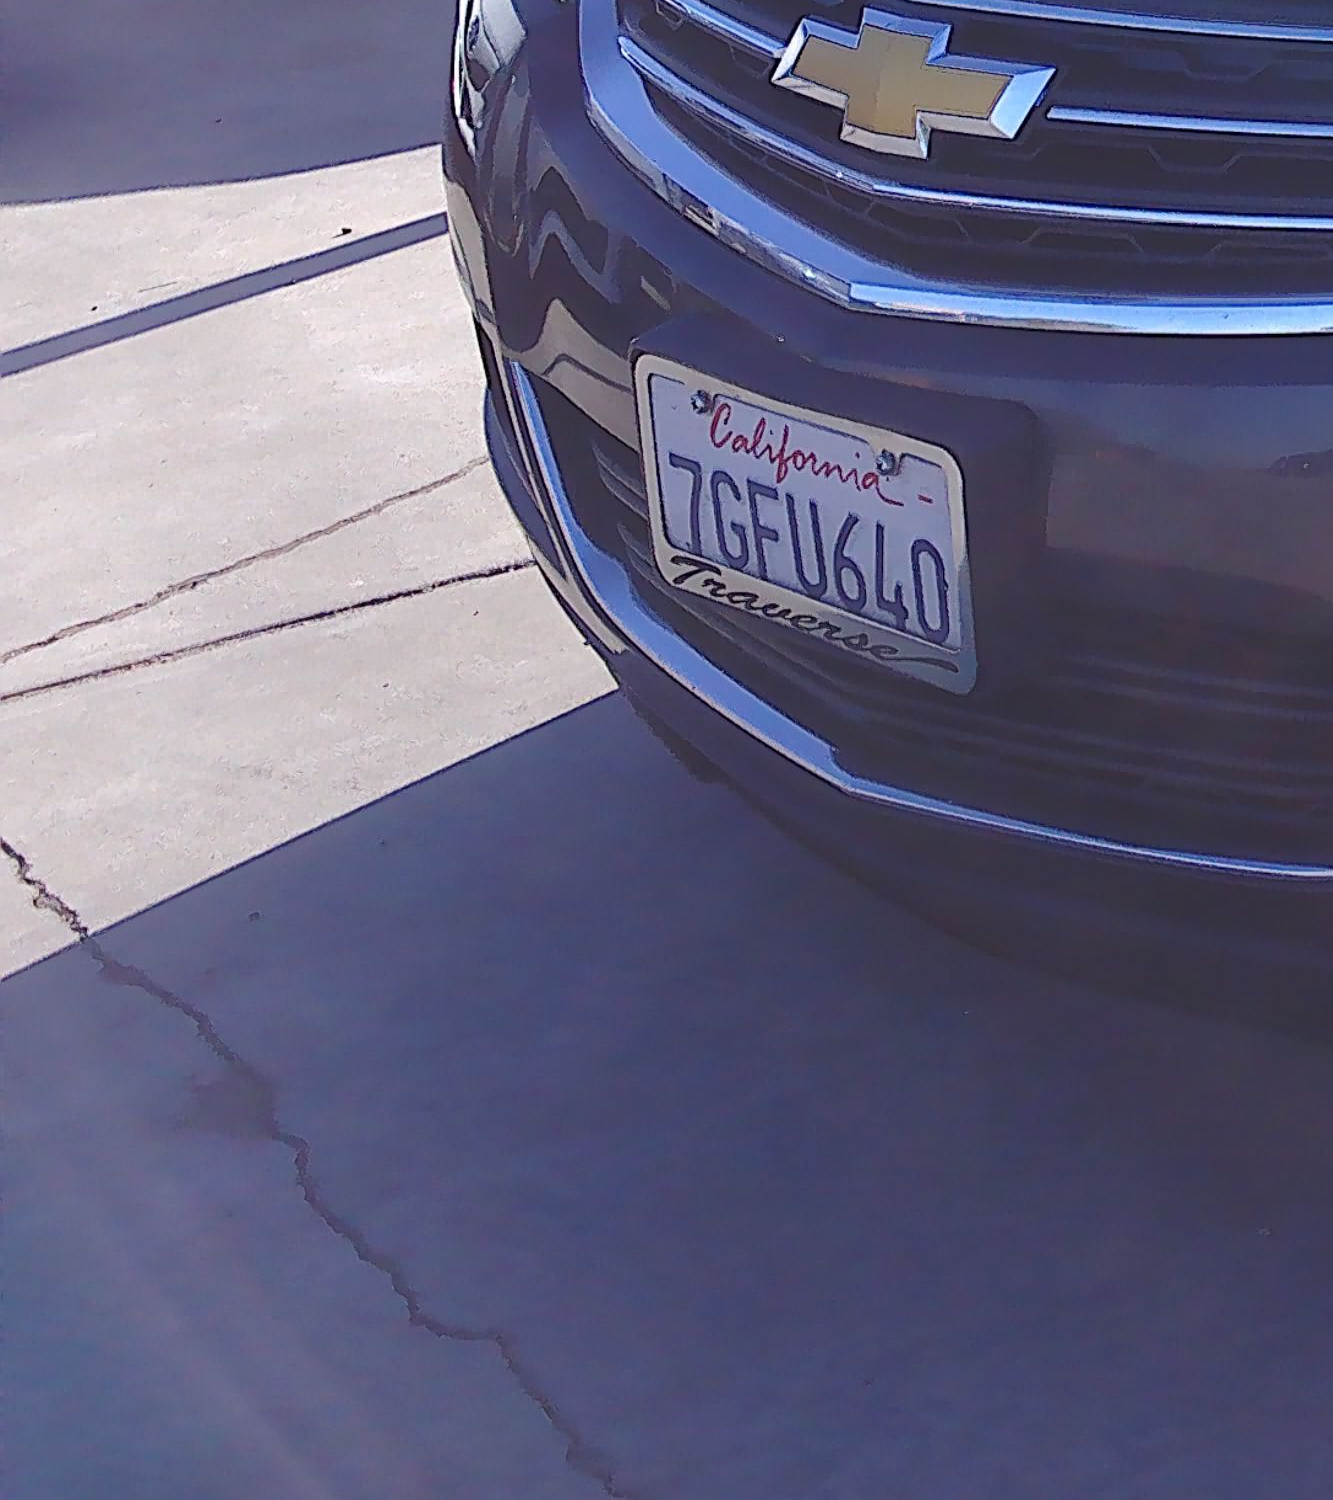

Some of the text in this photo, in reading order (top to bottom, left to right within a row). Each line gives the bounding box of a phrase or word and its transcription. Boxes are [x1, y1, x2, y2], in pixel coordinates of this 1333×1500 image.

[709, 403, 905, 507] California
[668, 451, 950, 645] 7GFU640
[670, 555, 960, 673] Traverse
